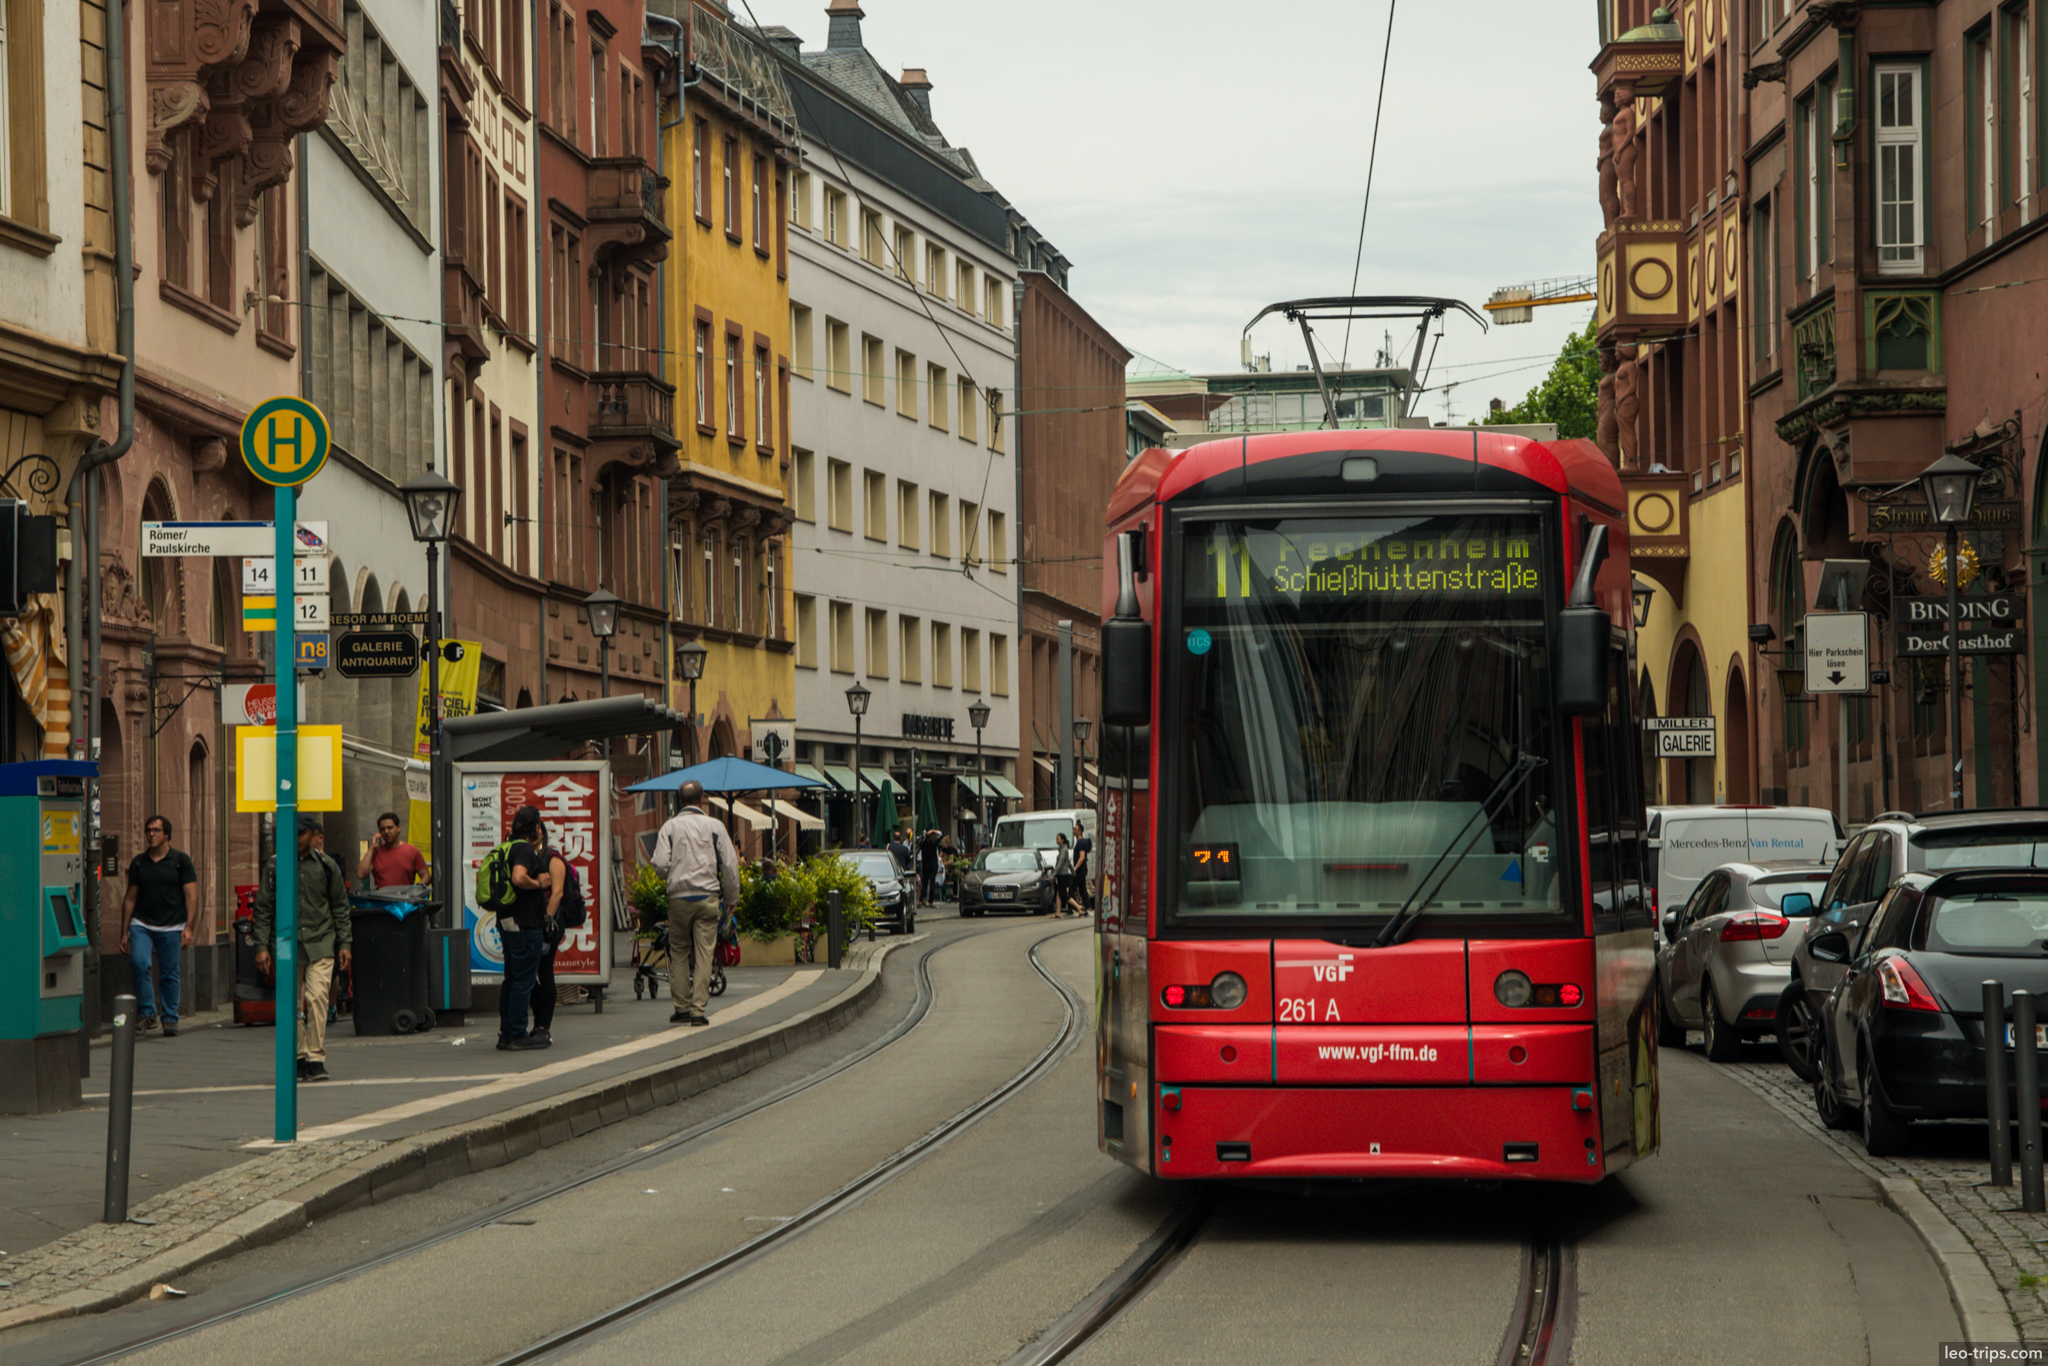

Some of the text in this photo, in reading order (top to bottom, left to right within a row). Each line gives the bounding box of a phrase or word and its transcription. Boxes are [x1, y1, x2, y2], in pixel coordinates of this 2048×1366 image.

[268, 417, 302, 465] H
[1873, 505, 1932, 529] Steine
[149, 529, 188, 540] Römer/
[149, 543, 211, 554] Paulskirche
[251, 567, 269, 582] 14
[300, 566, 316, 581] 11
[1206, 537, 1250, 597] 11
[1275, 562, 1538, 596] Schießhüttenstraße
[300, 604, 317, 619] 12
[330, 612, 430, 626] RESOR AM ROEME
[352, 641, 403, 653] GALERIE
[1188, 637, 1210, 646] ITCS
[301, 641, 327, 658] n8
[1808, 647, 1864, 657] Hier Parkschein
[341, 656, 415, 668] ANTIQUARIAT
[1826, 659, 1846, 668] lösen
[247, 696, 277, 707] HEUSSE
[1657, 719, 1708, 728] MILLER
[1662, 734, 1712, 752] GALERIE
[1669, 838, 1804, 849] Mercedes-Benz Van Rental
[1313, 954, 1354, 982] VGF
[1279, 998, 1341, 1022] 261 A
[1318, 1043, 1438, 1064] www.vgf-ffm.de
